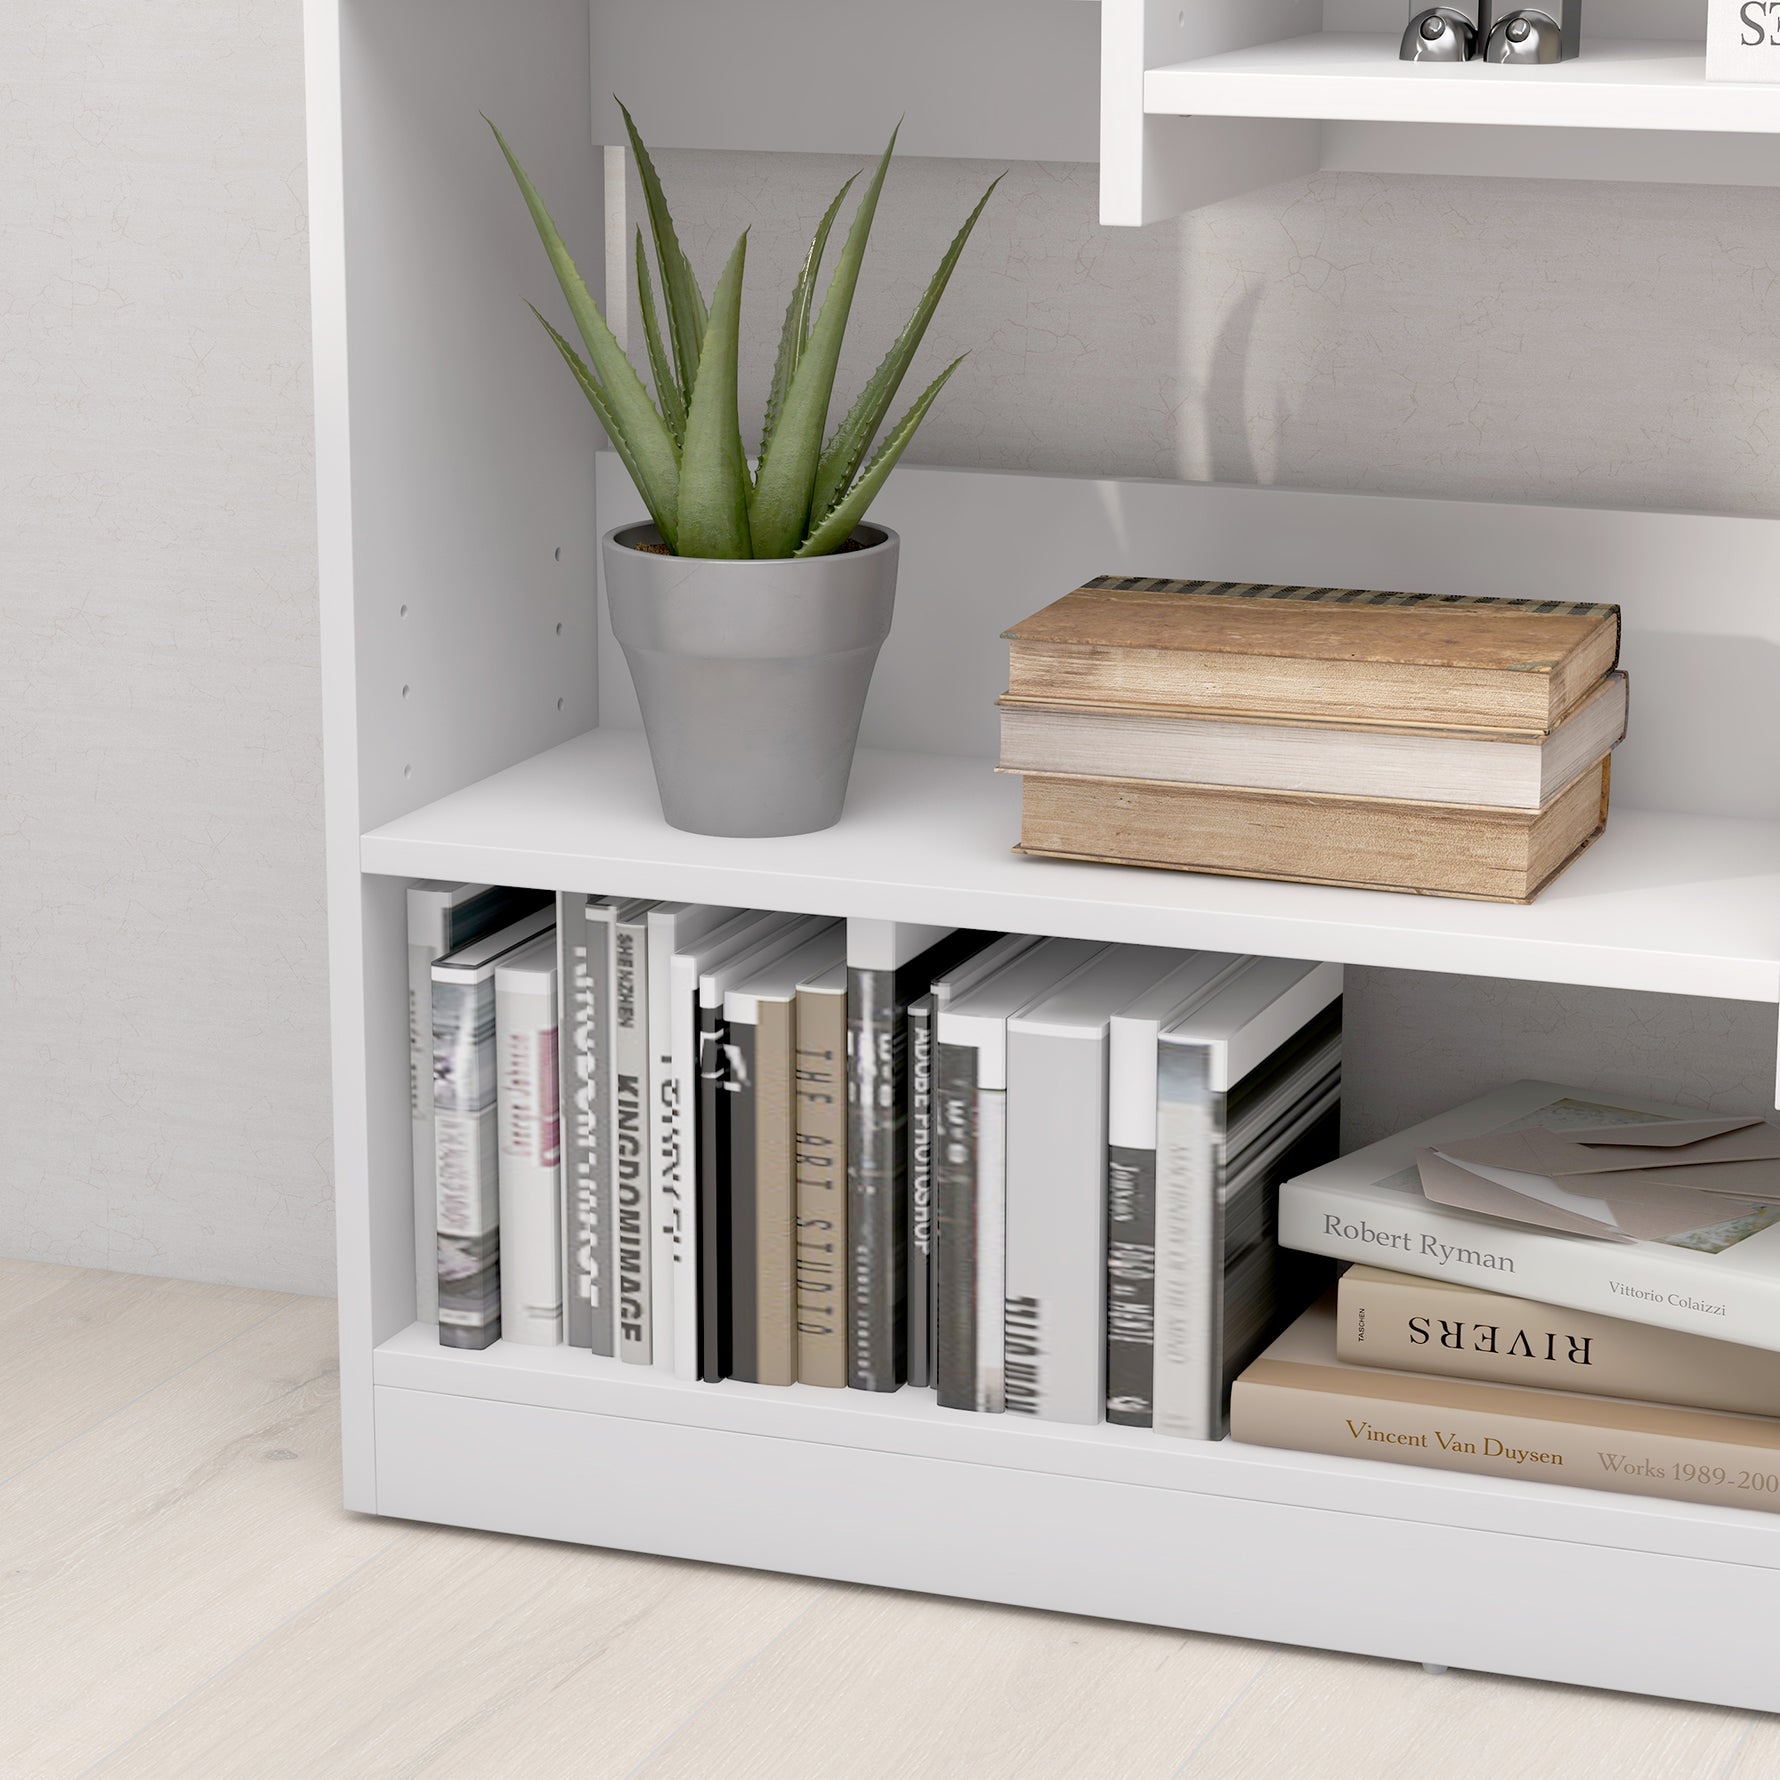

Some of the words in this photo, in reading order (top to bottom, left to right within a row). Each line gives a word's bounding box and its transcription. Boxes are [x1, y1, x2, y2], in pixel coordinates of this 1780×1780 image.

[617, 933, 634, 1029] SHENZHEN
[796, 1132, 833, 1191] ART
[1323, 1212, 1412, 1253] Robert
[1419, 1234, 1516, 1275] Ryman
[1609, 1280, 1664, 1304] Vittorio
[1668, 1293, 1727, 1317] Colaizzi
[1358, 1308, 1366, 1342] TASCHEN
[1408, 1316, 1593, 1366] RIVERS
[1345, 1419, 1428, 1449] Vincent
[1434, 1431, 1477, 1455] Van
[1483, 1436, 1564, 1467] Duysen
[1598, 1451, 1665, 1480] Works
